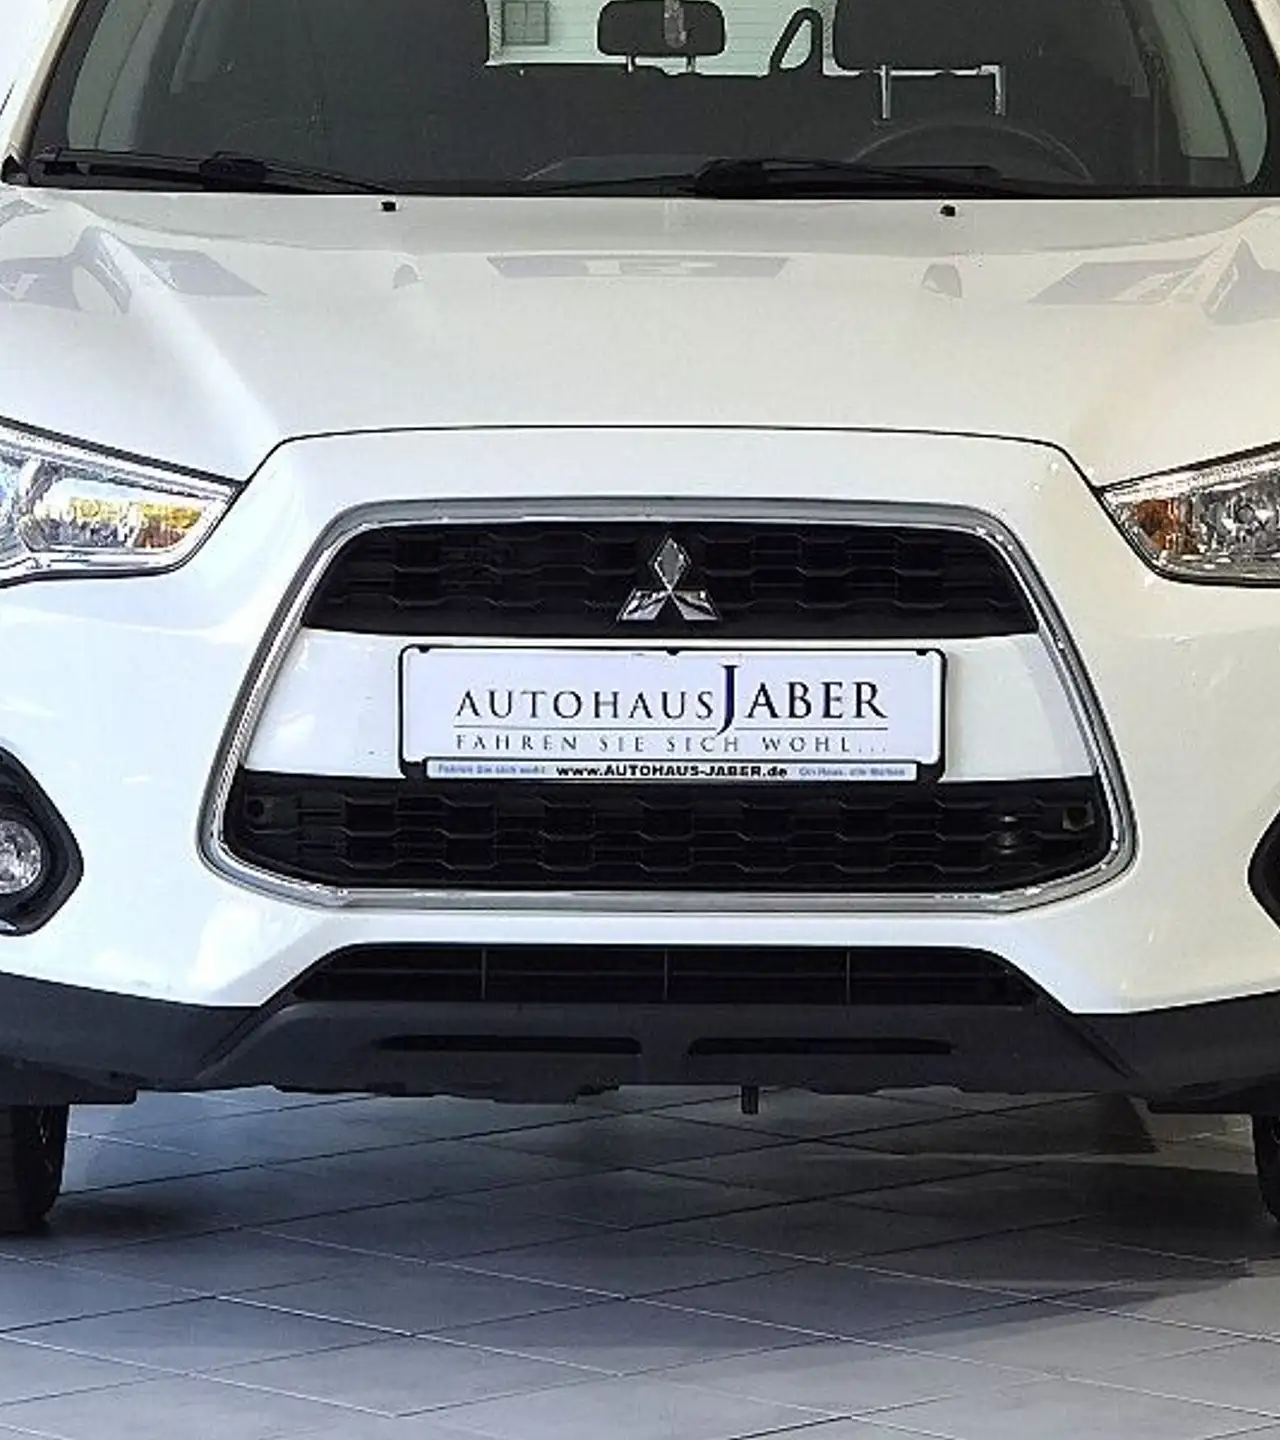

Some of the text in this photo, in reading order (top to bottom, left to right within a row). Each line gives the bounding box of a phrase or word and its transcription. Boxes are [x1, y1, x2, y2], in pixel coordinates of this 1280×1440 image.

[455, 663, 889, 736] AUTOHAUS JABER
[456, 733, 578, 751] FAHREN
[598, 735, 646, 752] SIE
[665, 735, 739, 753] SICH
[555, 764, 789, 780] www.AUTOHAUS-JABER.de
